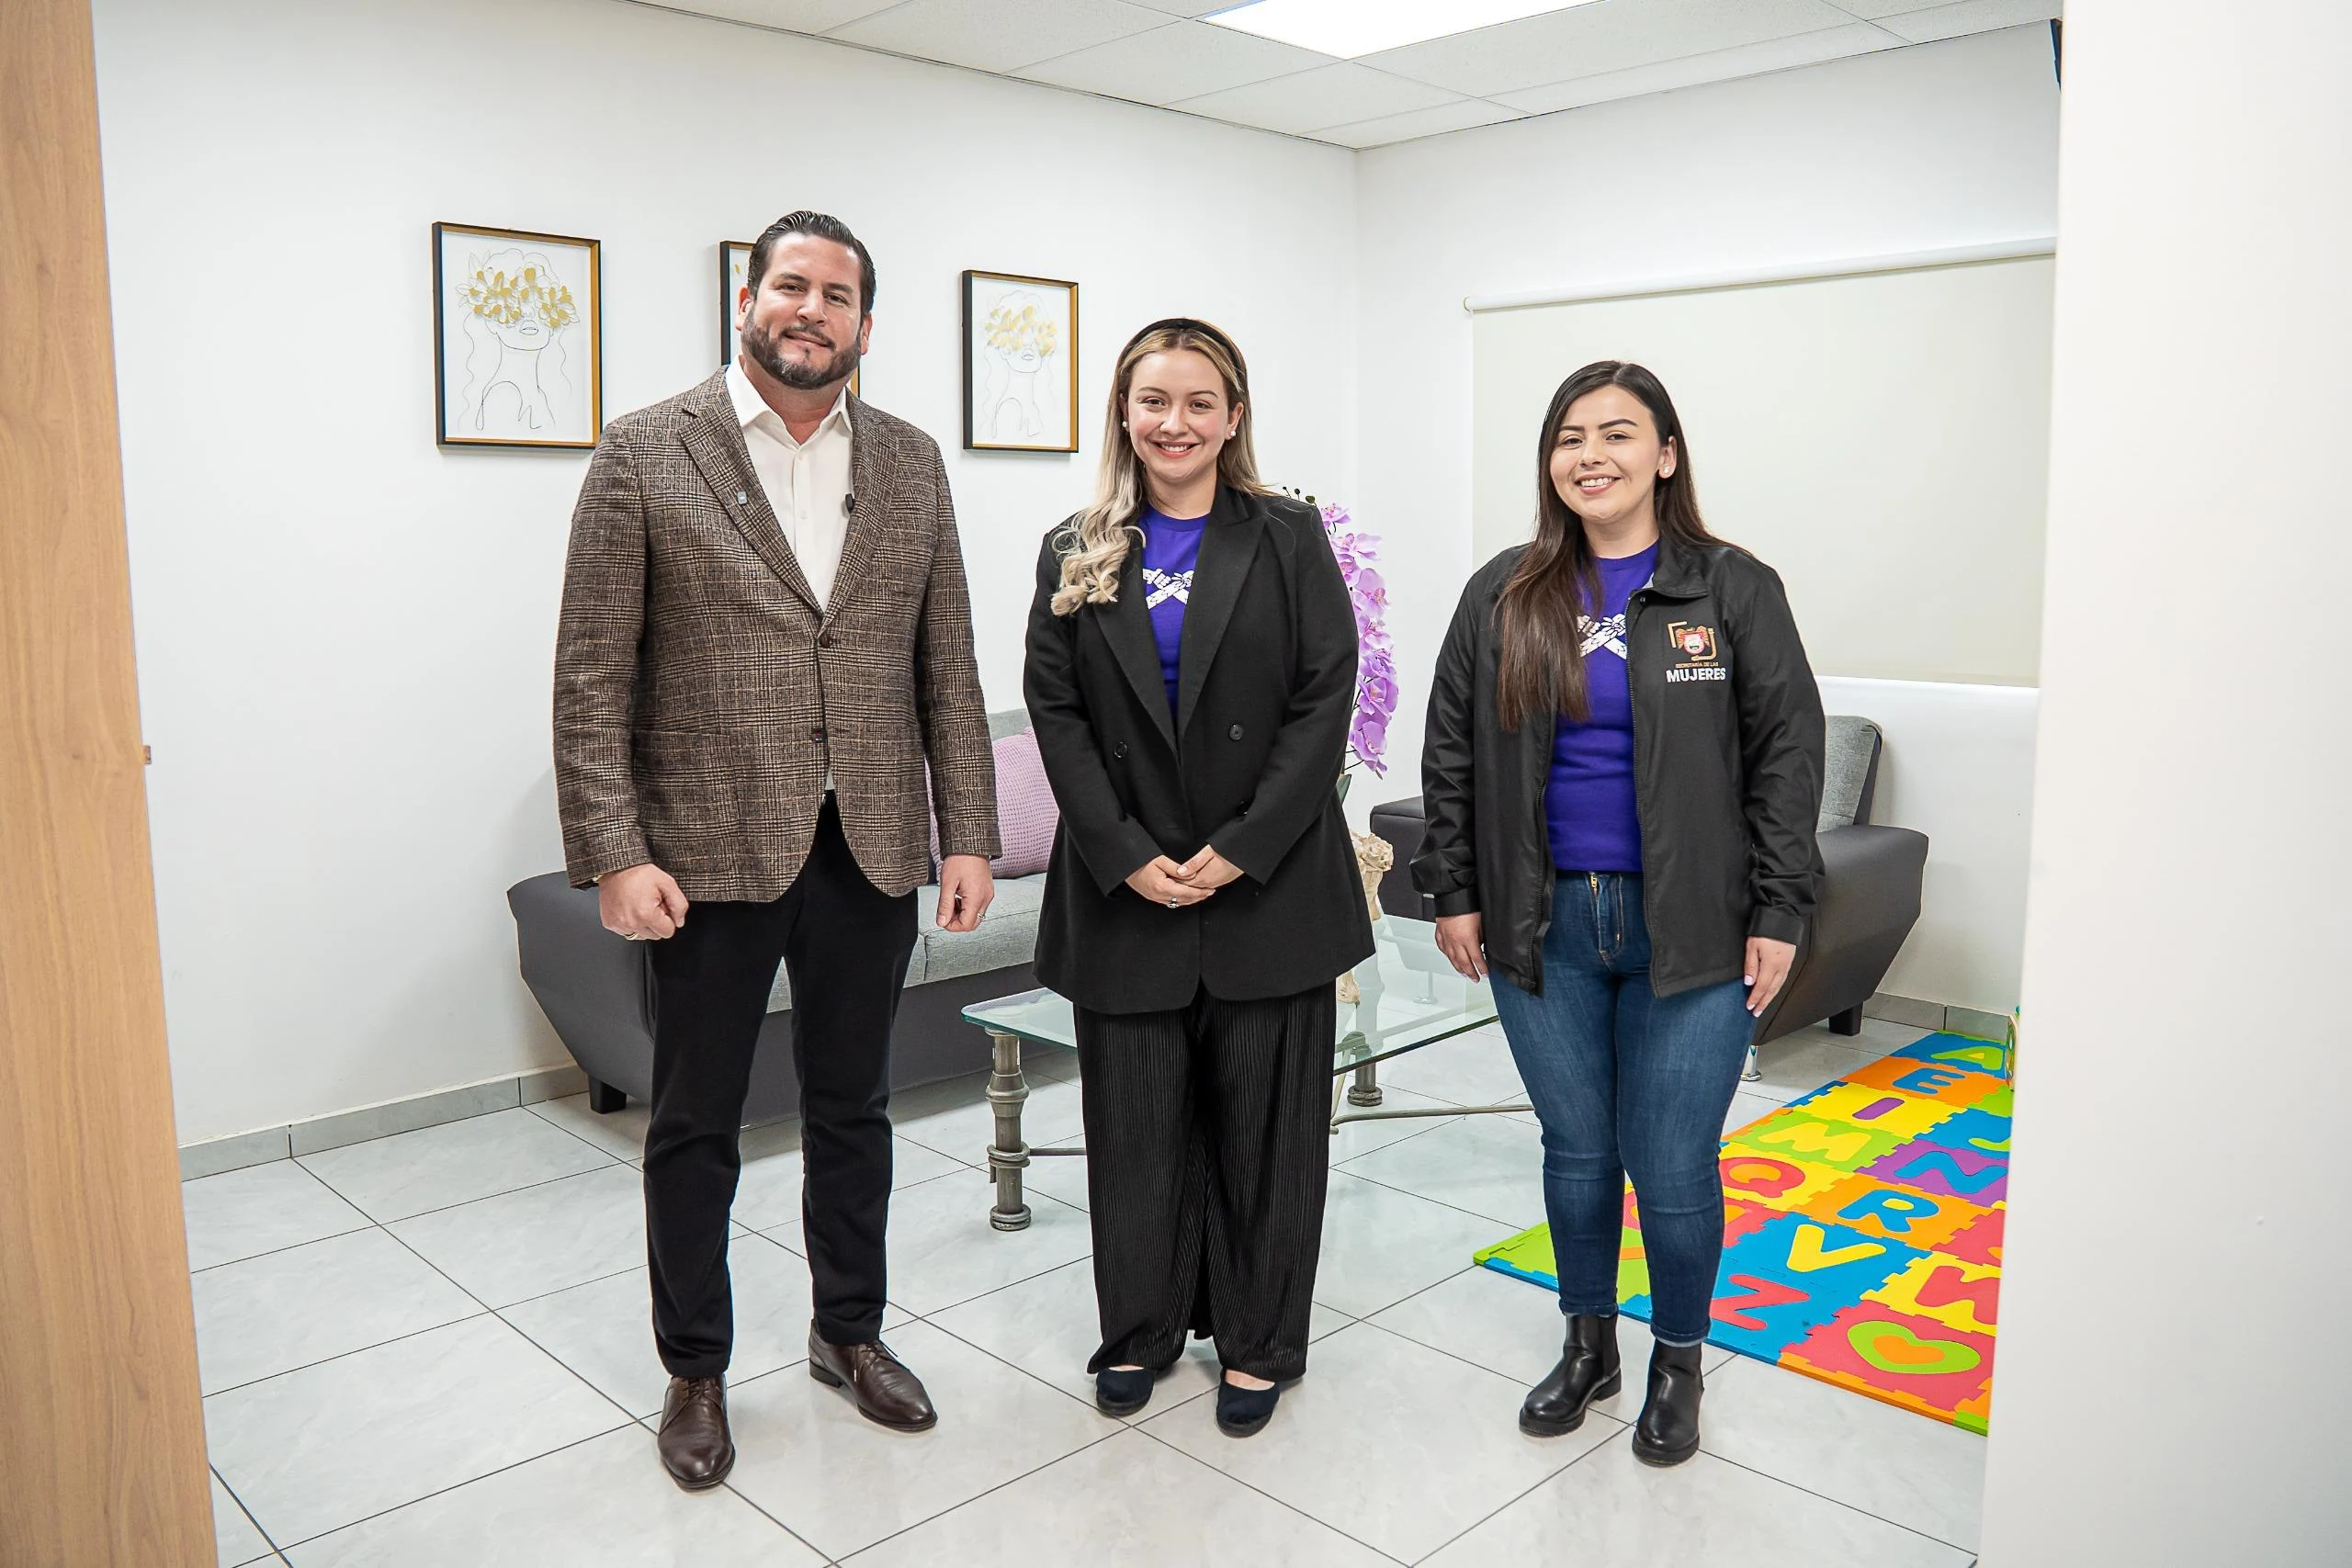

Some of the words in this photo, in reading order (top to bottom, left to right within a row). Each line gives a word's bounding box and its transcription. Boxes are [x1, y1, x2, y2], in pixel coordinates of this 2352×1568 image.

[1666, 668, 1726, 682] MUJERES
[1930, 1045, 2004, 1071] A
[1892, 1066, 1967, 1095] E
[1757, 1122, 1872, 1162] M
[1718, 1156, 1805, 1198] Q
[1894, 1151, 2008, 1195] N
[1837, 1189, 1940, 1233] R
[1786, 1224, 1887, 1272] V
[1708, 1273, 1810, 1330] Z
